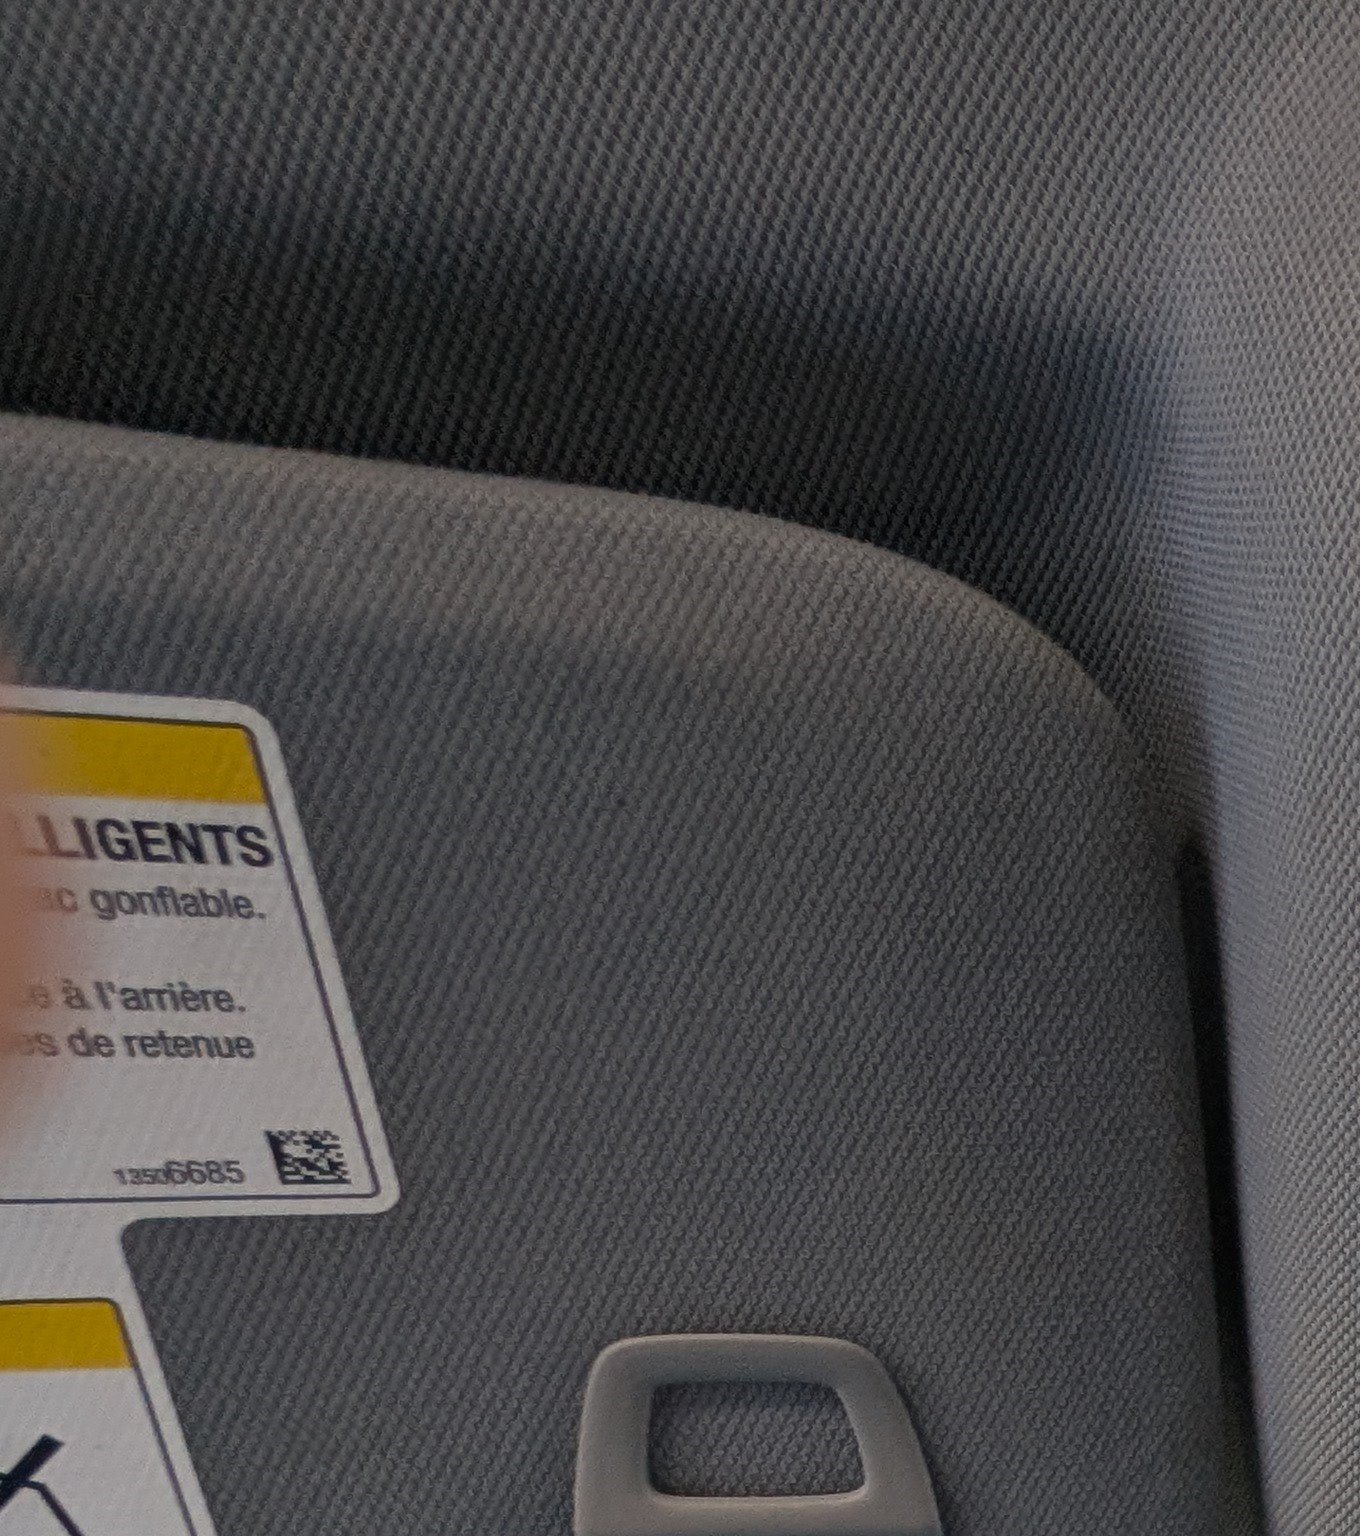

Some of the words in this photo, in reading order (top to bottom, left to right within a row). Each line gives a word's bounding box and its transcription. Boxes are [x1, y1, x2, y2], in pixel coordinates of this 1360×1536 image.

[20, 815, 274, 868] LIGENTS
[89, 886, 266, 920] gonflable.
[94, 981, 247, 1013] l'arrière.
[67, 1027, 116, 1058] de
[123, 1031, 256, 1059] retenue
